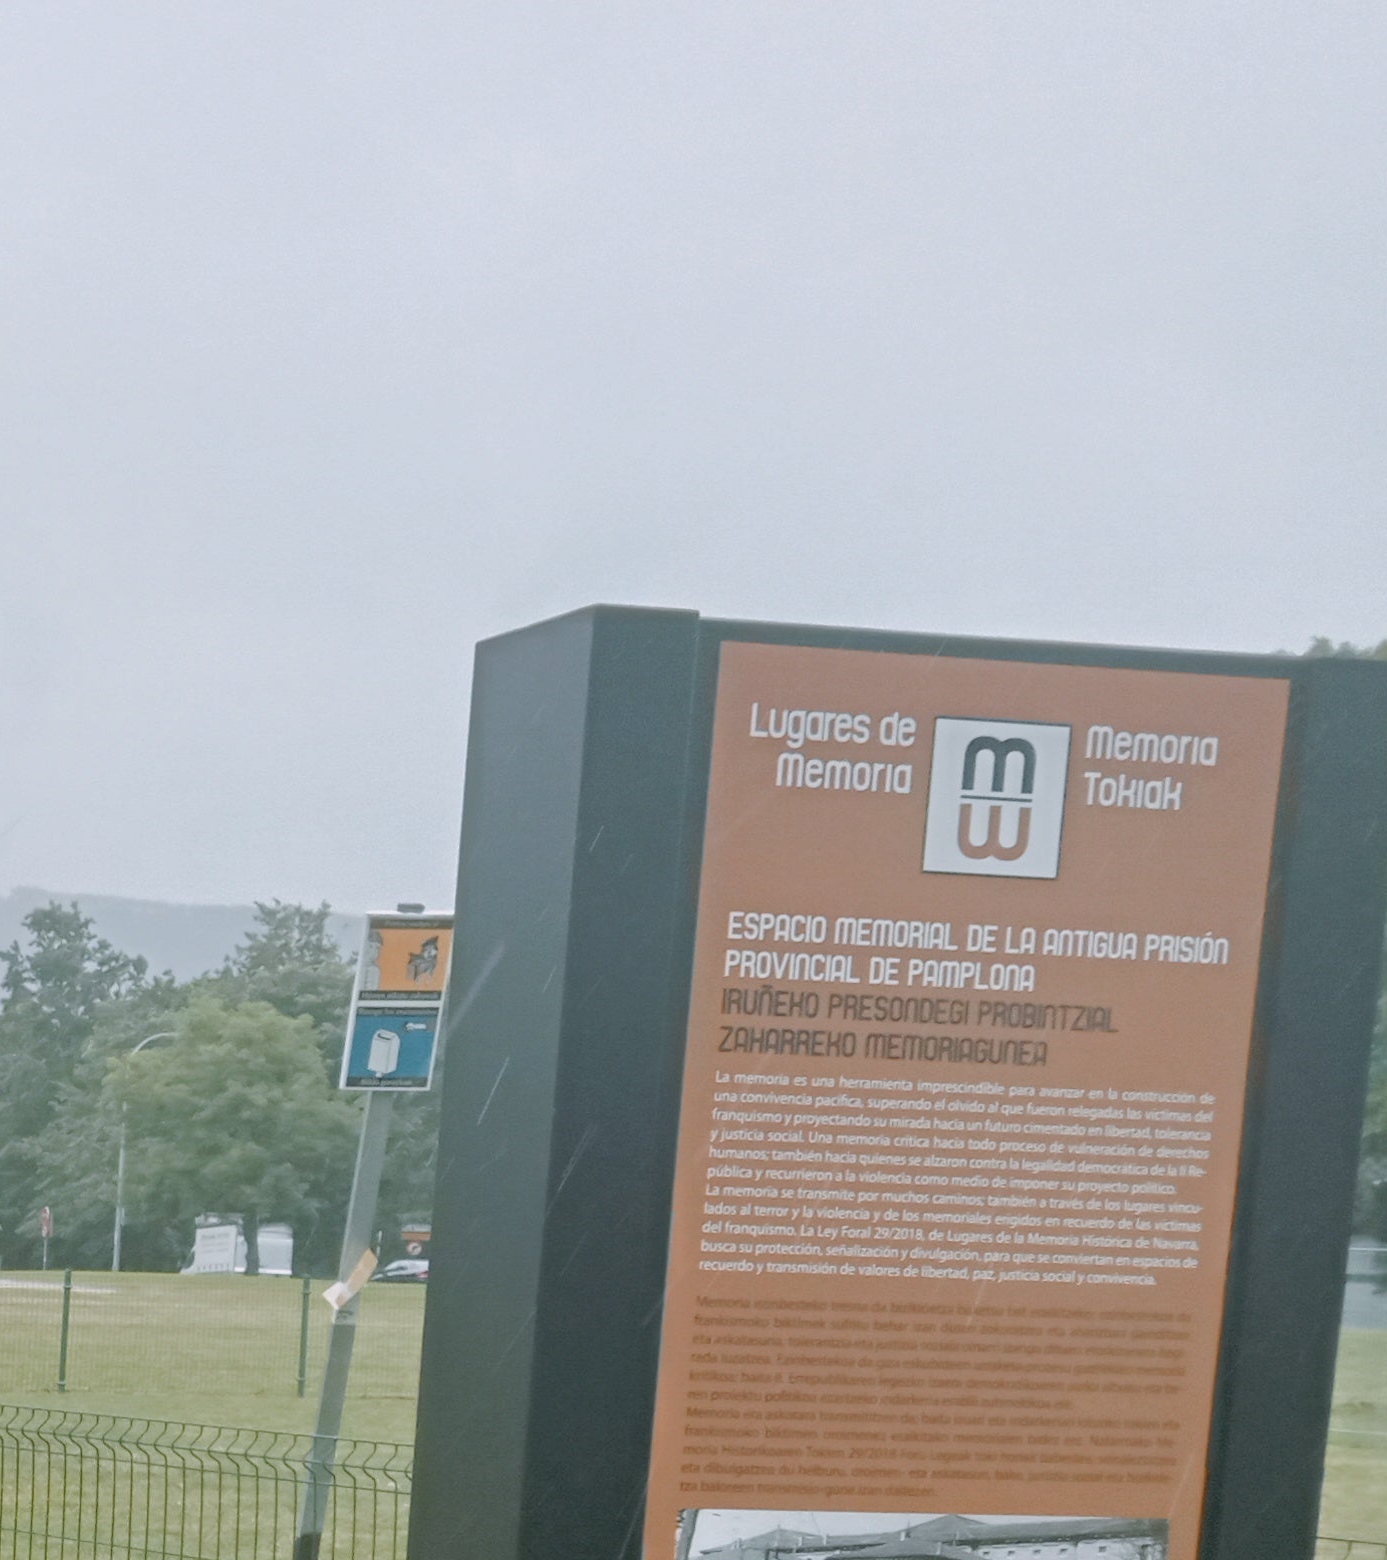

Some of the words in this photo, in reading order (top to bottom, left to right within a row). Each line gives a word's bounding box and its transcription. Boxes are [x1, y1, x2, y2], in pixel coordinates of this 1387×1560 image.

[750, 702, 870, 748] Lugares
[880, 711, 917, 746] de
[1086, 724, 1219, 767] Memoria
[776, 753, 912, 794] Memoria
[1083, 771, 1182, 811] Tokiak
[727, 911, 827, 944] ESPACIO
[834, 917, 957, 951] MEMORIAL
[967, 925, 997, 954] DE
[1005, 926, 1035, 955] LA
[1042, 929, 1136, 959] ANTIGUA
[1144, 931, 1228, 965] PRISIÓN
[724, 951, 860, 985] PROVINCIAL
[870, 956, 902, 986] DE
[908, 959, 1035, 992] PAMPLONA
[714, 1092, 737, 1102] una
[933, 1098, 945, 1110] el
[987, 1101, 998, 1112] al
[1000, 1105, 1023, 1115] que
[1127, 1108, 1141, 1119] las
[1193, 1110, 1213, 1122] del
[715, 1070, 729, 1082] La
[793, 1077, 807, 1086] es
[811, 1078, 834, 1087] una
[1087, 1090, 1103, 1098] en
[1107, 1088, 1117, 1099] la
[1200, 1093, 1215, 1104] de
[710, 1129, 718, 1142] y
[808, 1131, 832, 1143] Una
[1049, 1142, 1065, 1152] de
[1138, 1145, 1153, 1156] de
[705, 1184, 719, 1195] La
[781, 1189, 794, 1198] se
[857, 1192, 879, 1203] por
[1039, 1199, 1046, 1207] a
[1086, 1198, 1102, 1209] de
[1104, 1198, 1120, 1210] los
[755, 1170, 763, 1180] y
[835, 1172, 842, 1181] a
[845, 1170, 855, 1181] la
[991, 1176, 1006, 1187] de
[1061, 1181, 1075, 1190] su
